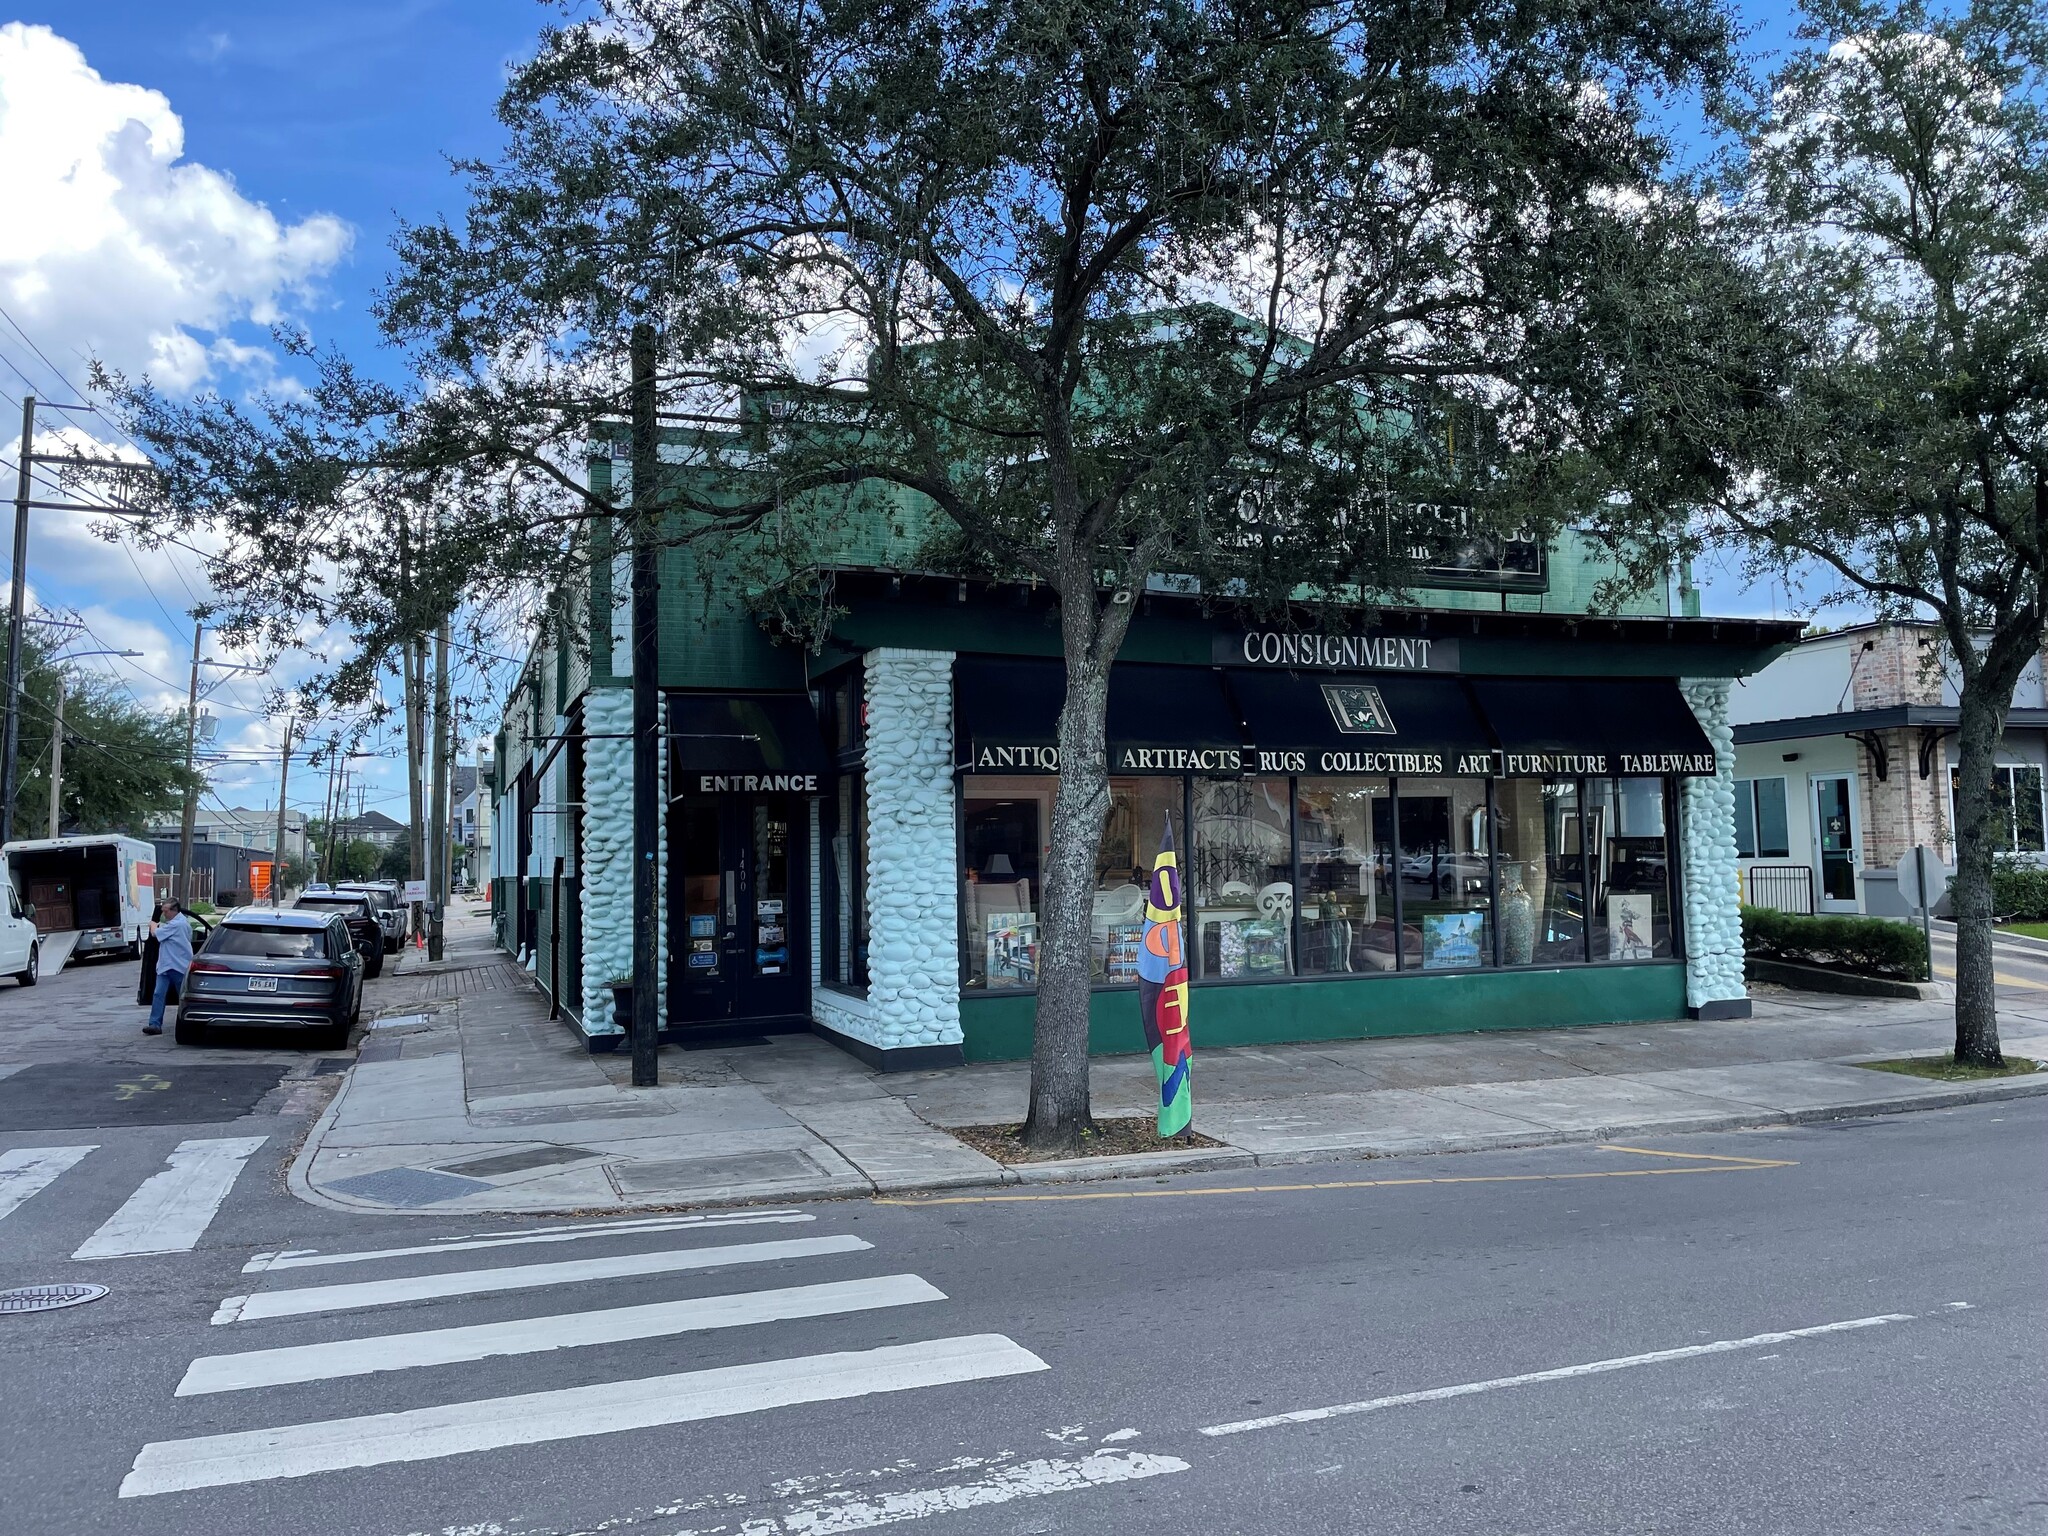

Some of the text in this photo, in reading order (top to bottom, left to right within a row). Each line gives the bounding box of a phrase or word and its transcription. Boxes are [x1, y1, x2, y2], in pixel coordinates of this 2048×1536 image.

[1243, 632, 1431, 669] CONSIGNMENT
[978, 746, 1714, 773] ANTIQ ARTIFACTS RUGS COLLECTIBLES ART FURNITURE TABLEWARE
[700, 775, 817, 791] ENTRANCE
